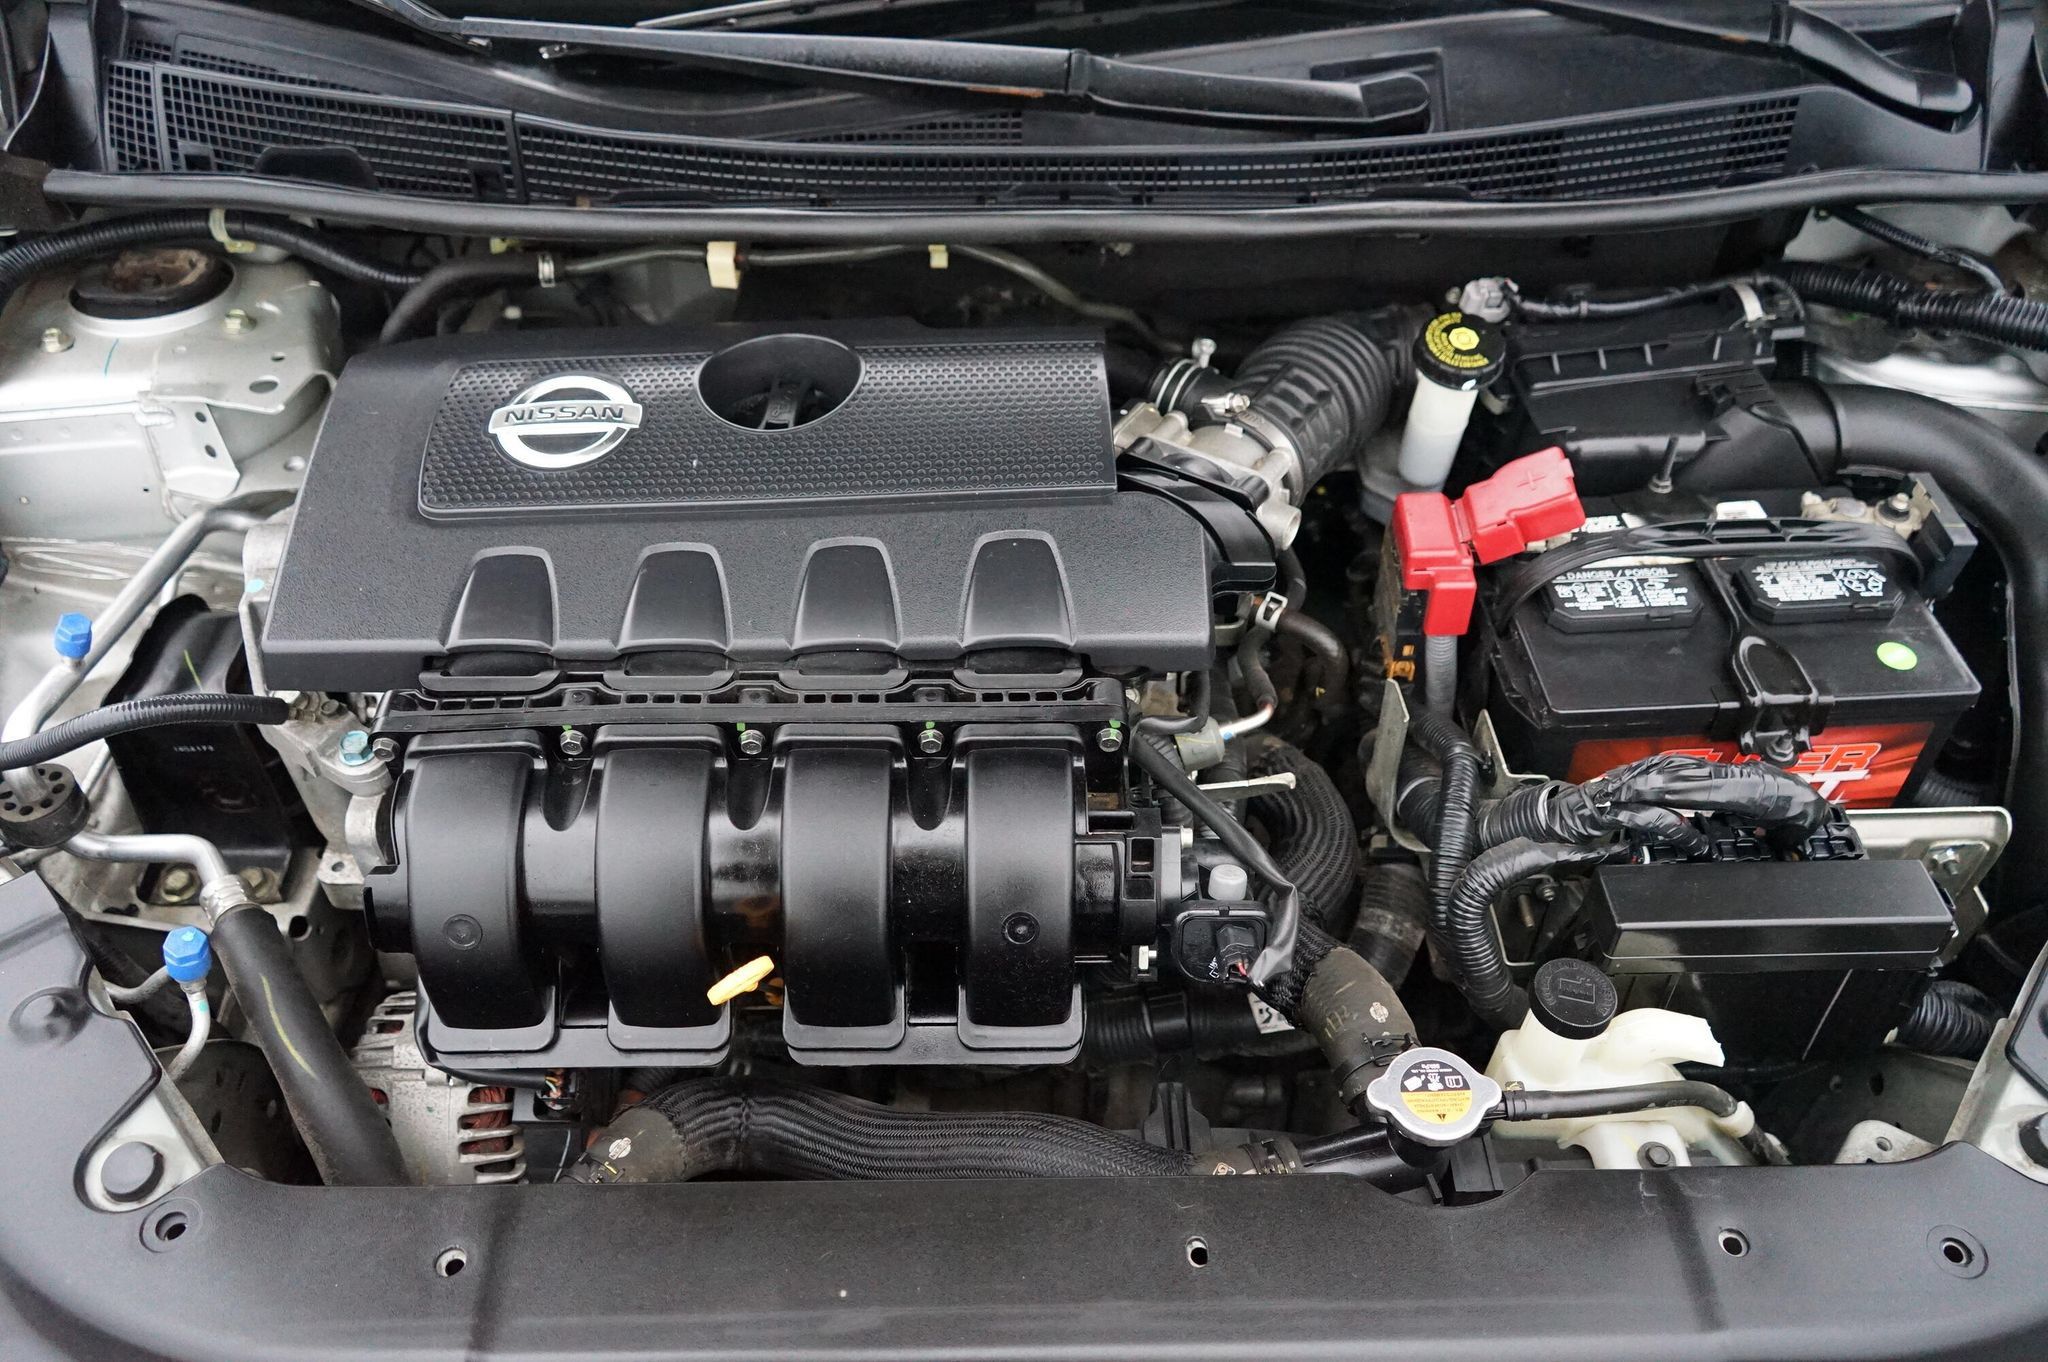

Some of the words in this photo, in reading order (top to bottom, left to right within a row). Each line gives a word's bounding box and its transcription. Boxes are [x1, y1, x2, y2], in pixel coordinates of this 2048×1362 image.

[504, 406, 624, 423] NISSAN
[1566, 569, 1614, 580] DANGER
[1624, 567, 1669, 577] POISON
